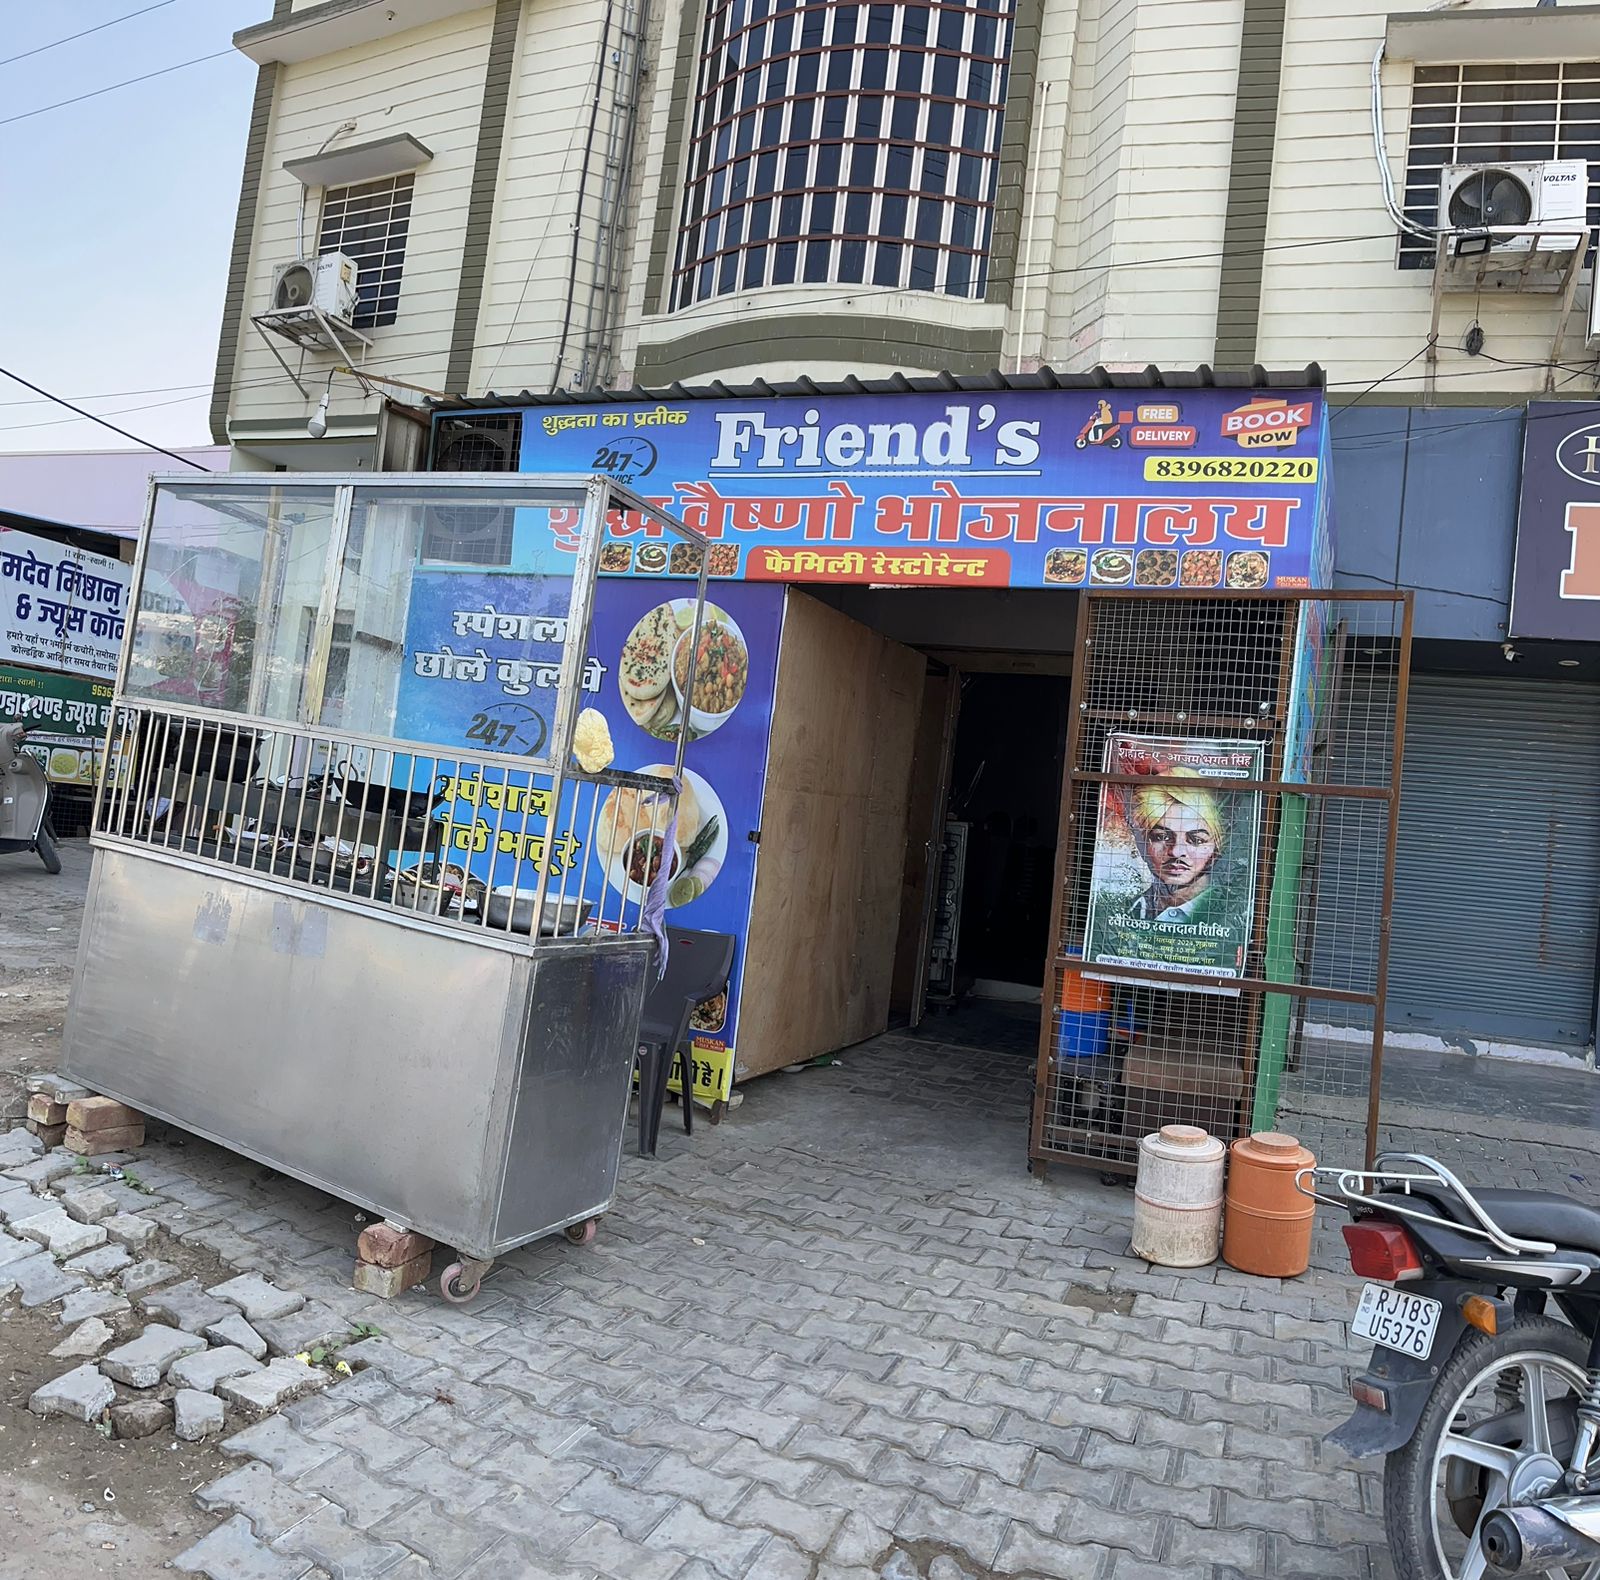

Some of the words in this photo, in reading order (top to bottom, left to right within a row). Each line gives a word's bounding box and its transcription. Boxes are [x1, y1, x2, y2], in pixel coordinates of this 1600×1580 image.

[1543, 174, 1577, 183] VOLTAS
[542, 413, 598, 436] शुद्धता
[602, 412, 629, 427] का
[633, 405, 689, 428] प्रतीक
[1142, 408, 1173, 420] FREE
[1226, 407, 1305, 431] BOOK
[1135, 431, 1191, 442] DELIVERY
[1247, 431, 1292, 445] NOW
[1155, 460, 1313, 478] 8396820220
[672, 480, 865, 541] वैष्णो
[875, 480, 1302, 547] भोजनालय
[763, 549, 867, 577] फैमिली
[871, 552, 988, 578] रेस्टोरेन्ट
[16, 593, 32, 620] &
[453, 605, 569, 643] स्पेशल
[6, 630, 24, 641] हमारे
[40, 637, 49, 647] पर
[64, 656, 72, 665] हर
[73, 657, 91, 667] समय
[92, 659, 107, 672] तैयार
[414, 646, 491, 682] छोले
[65, 700, 98, 734] ज्यूस
[465, 713, 516, 747] 247
[1203, 754, 1228, 766] भगत
[1231, 753, 1252, 767] सिंह
[1152, 921, 1196, 936] रक्तदान
[1198, 922, 1231, 938] शिविर
[1376, 1289, 1433, 1326] RJ18S
[1369, 1314, 1426, 1353] U5376
